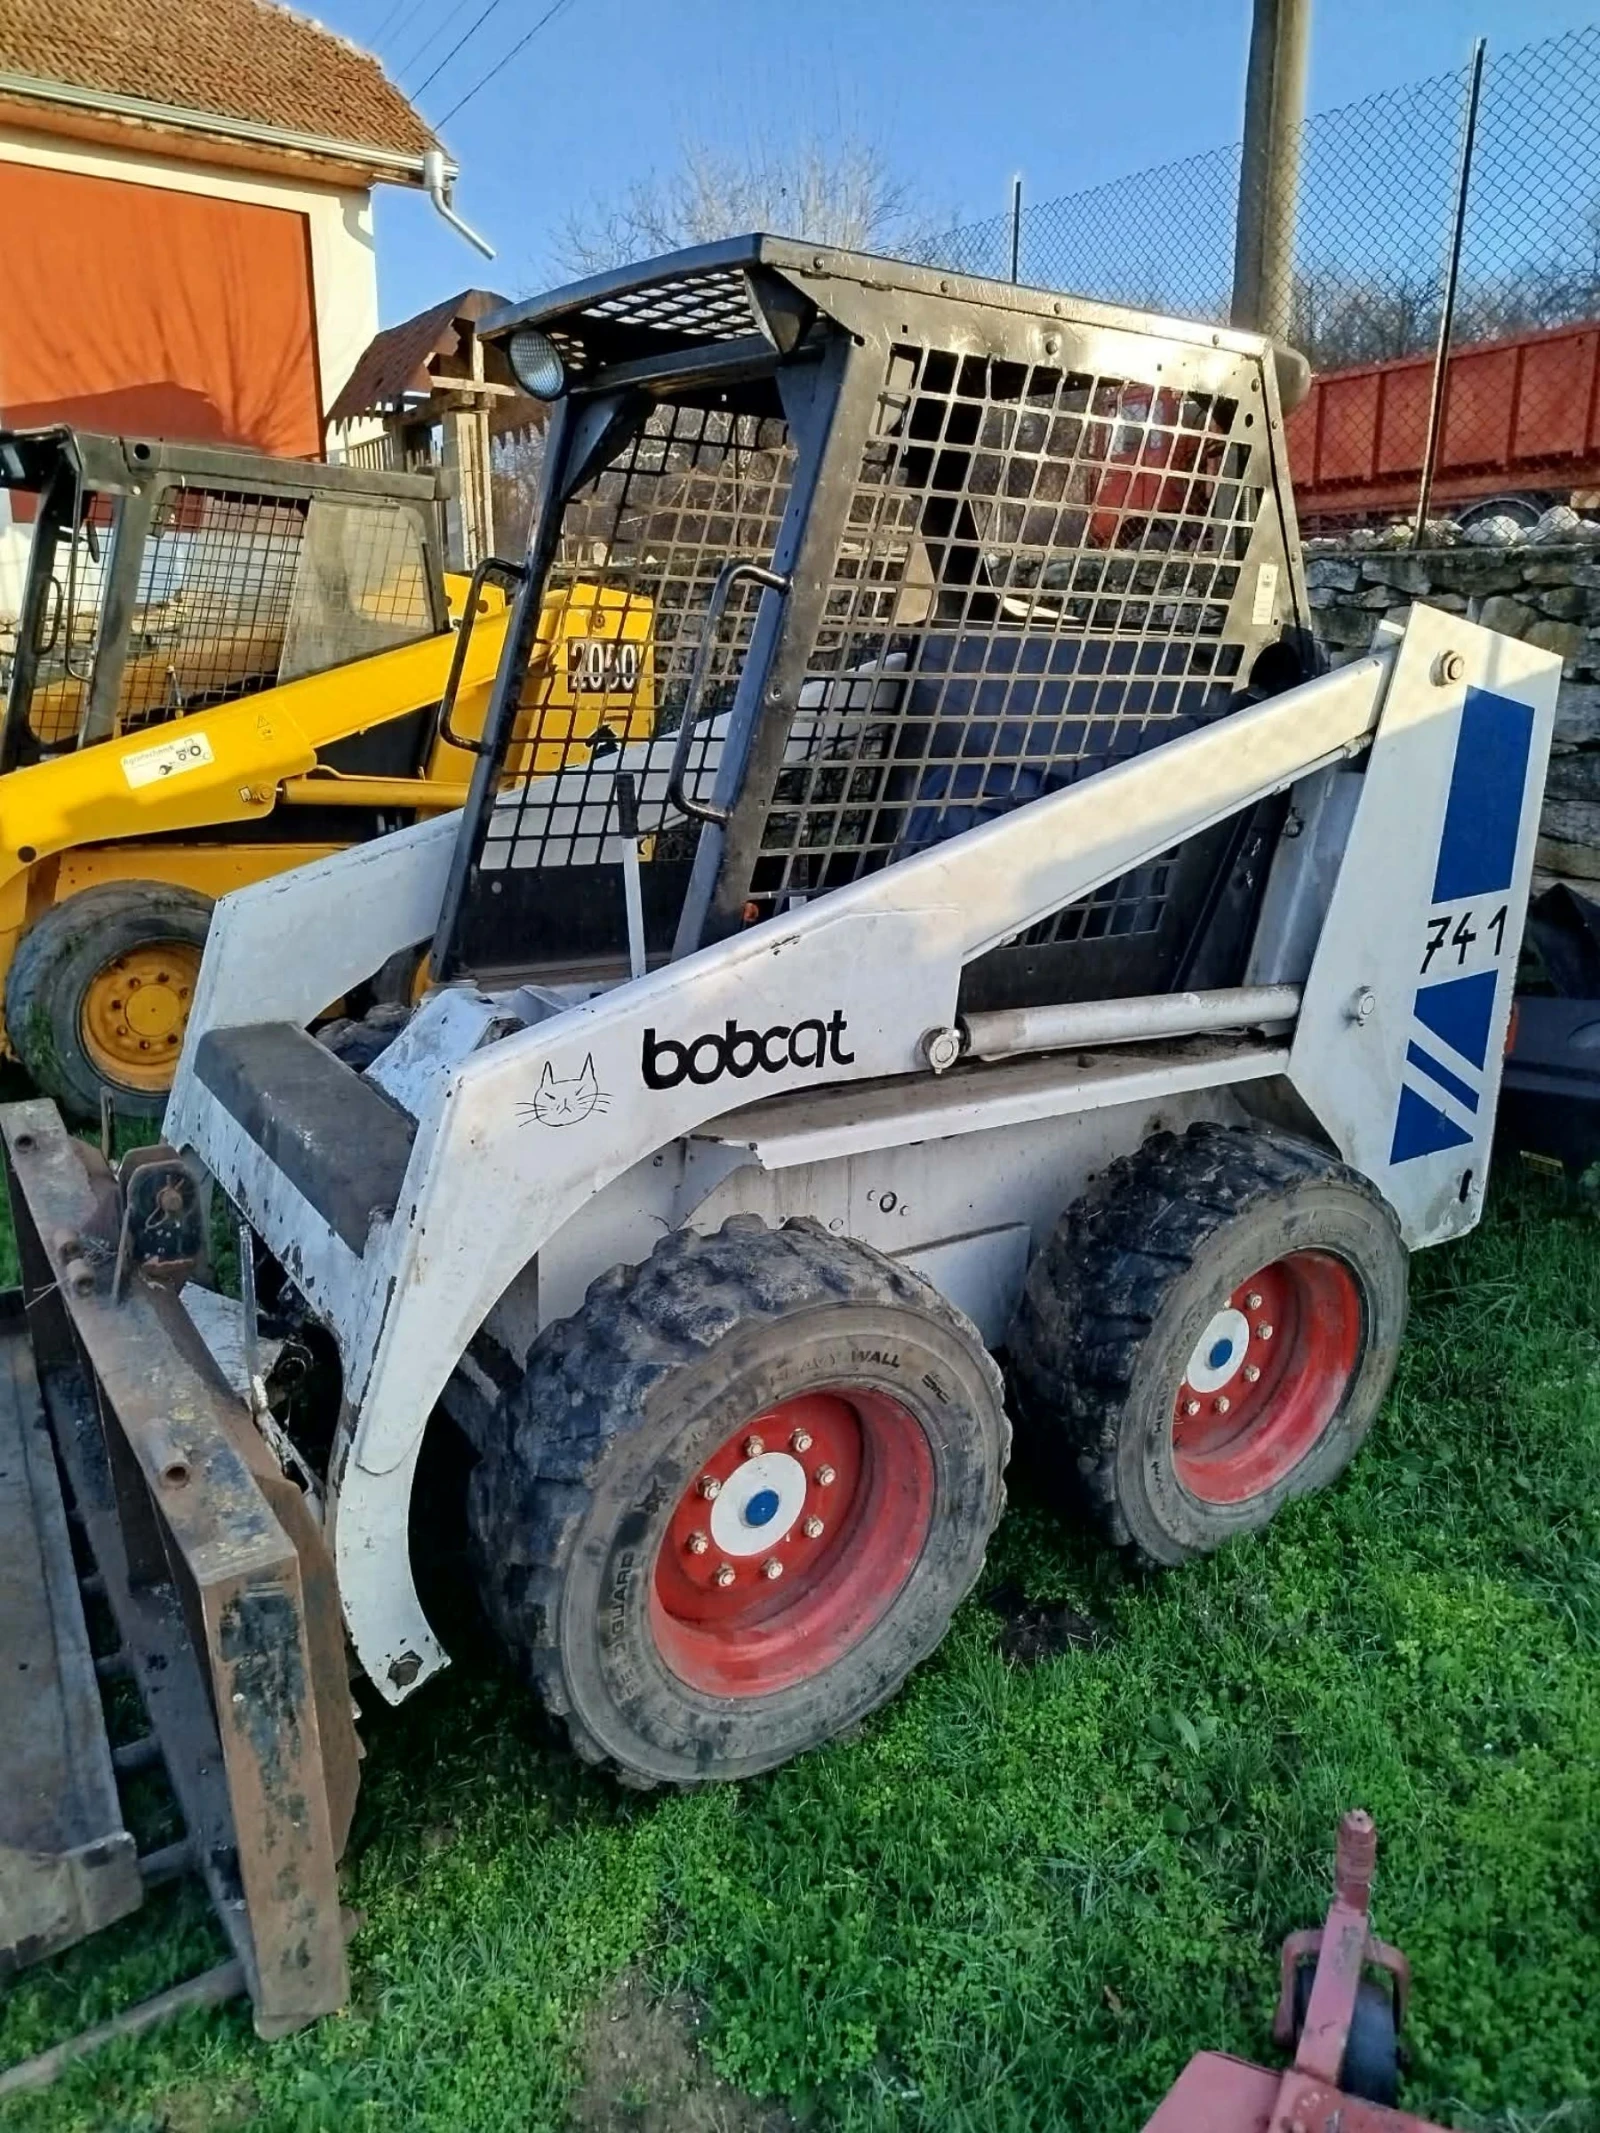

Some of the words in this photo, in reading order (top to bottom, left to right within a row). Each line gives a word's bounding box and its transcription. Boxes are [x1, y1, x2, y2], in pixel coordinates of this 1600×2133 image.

[1420, 904, 1508, 975] 741
[641, 1009, 855, 1090] bobcat
[851, 1350, 901, 1369] WALL
[611, 1551, 635, 1636] GUARD
